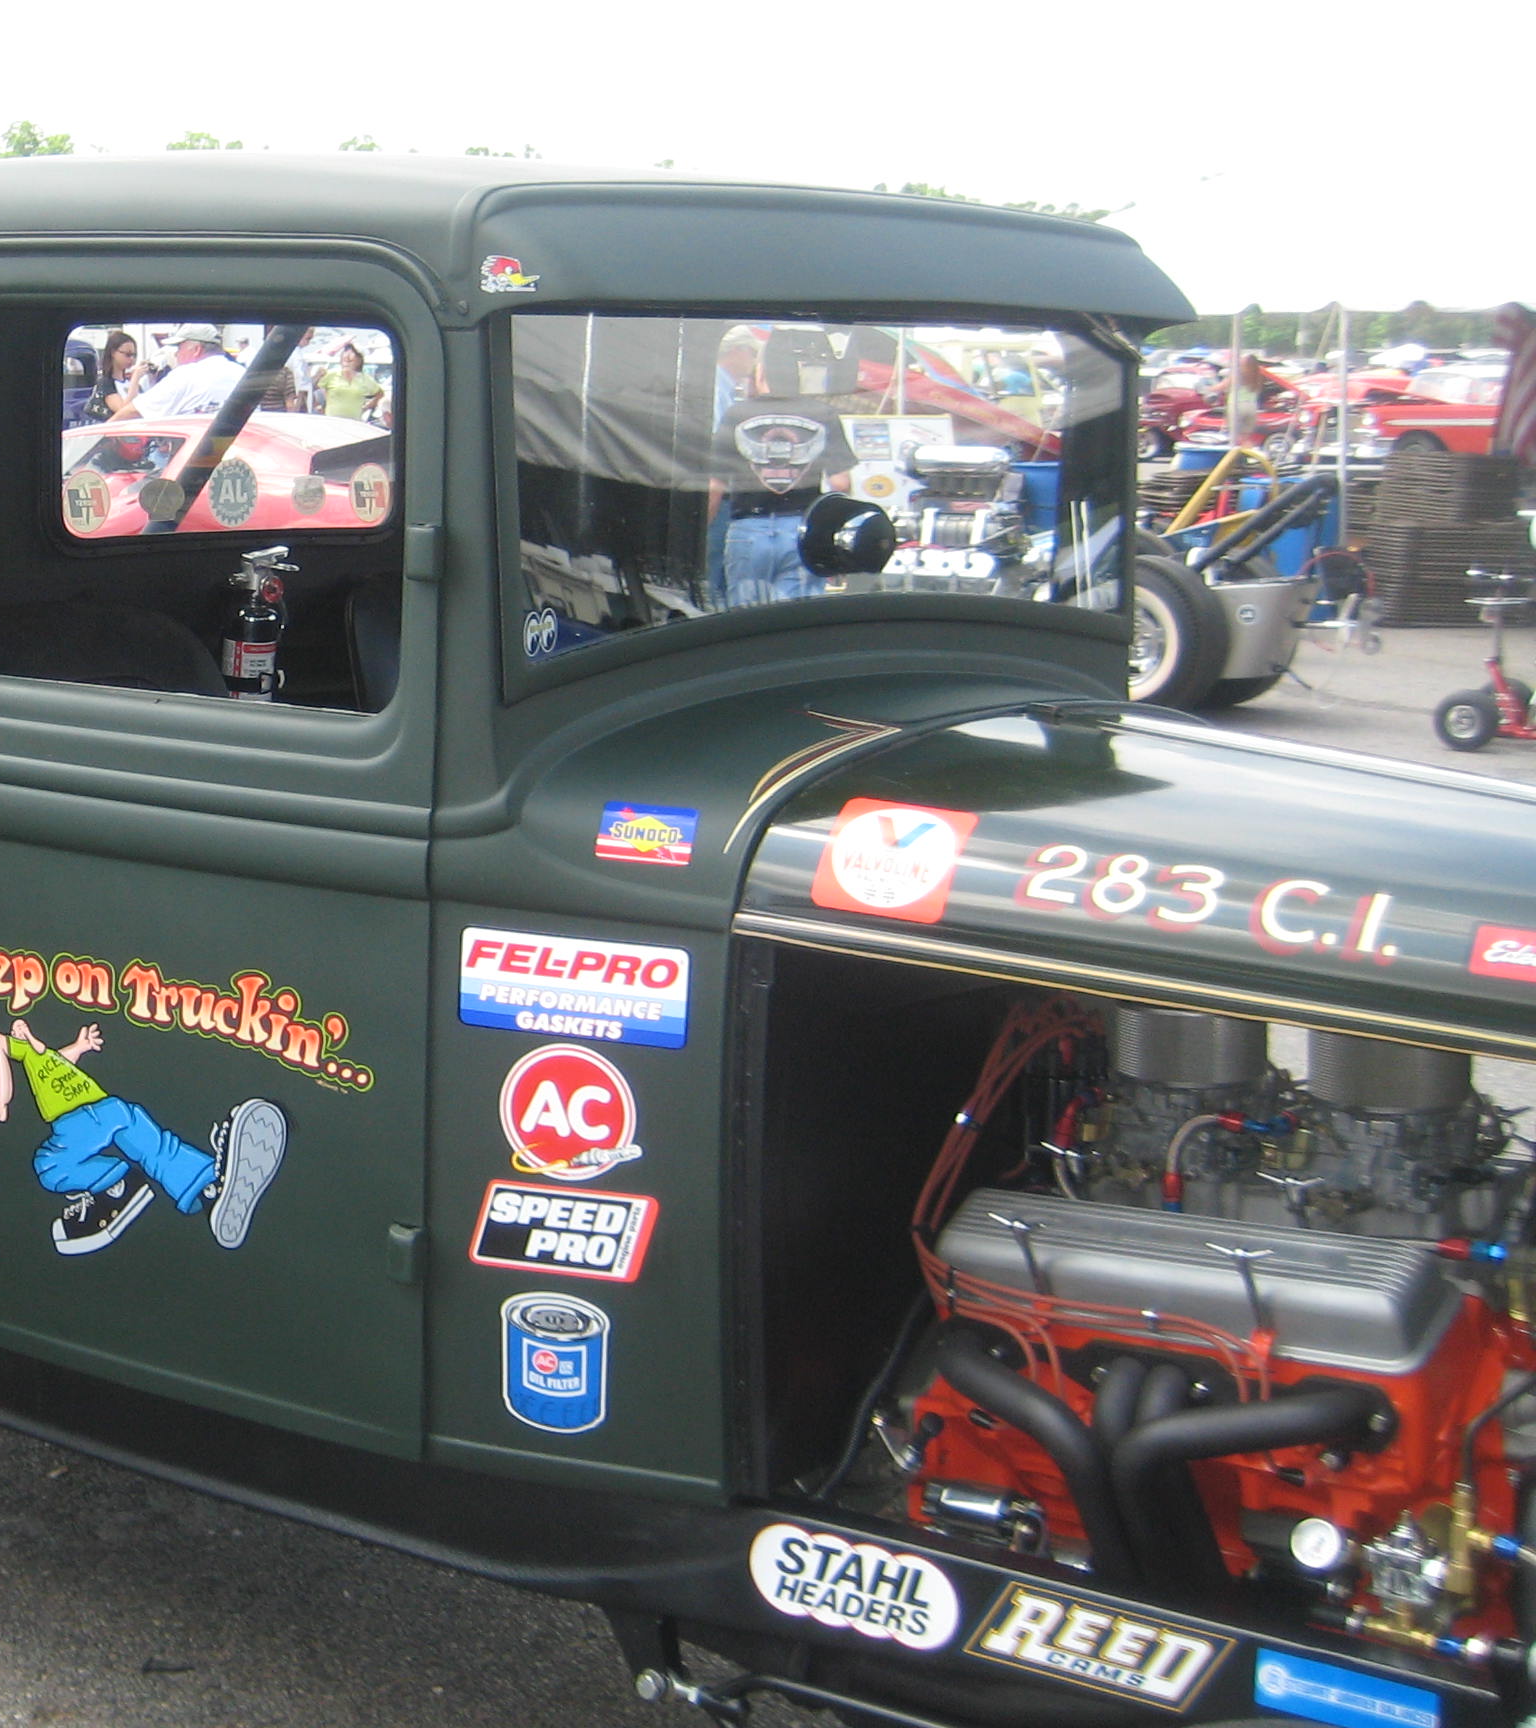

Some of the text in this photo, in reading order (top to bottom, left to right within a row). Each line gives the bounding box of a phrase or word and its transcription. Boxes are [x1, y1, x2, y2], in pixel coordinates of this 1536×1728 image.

[613, 822, 679, 845] SUNOCO
[843, 850, 930, 884] VALVOLINE
[1017, 843, 1399, 964] 283 C.I.
[53, 955, 117, 1010] on
[465, 938, 681, 990] FEL-PRO
[478, 982, 663, 1021] PERFORMANCE
[515, 1010, 624, 1041] GASKETS
[62, 1080, 91, 1102] Shop
[519, 1079, 612, 1142] AC
[489, 1190, 628, 1234] SPEED
[524, 1228, 618, 1268] PRO
[528, 1370, 581, 1390] OIL FILTER
[775, 1537, 929, 1609] STAHL
[774, 1575, 930, 1636] HEADERS
[980, 1589, 1214, 1702] REED
[1046, 1651, 1147, 1688] CAMS
